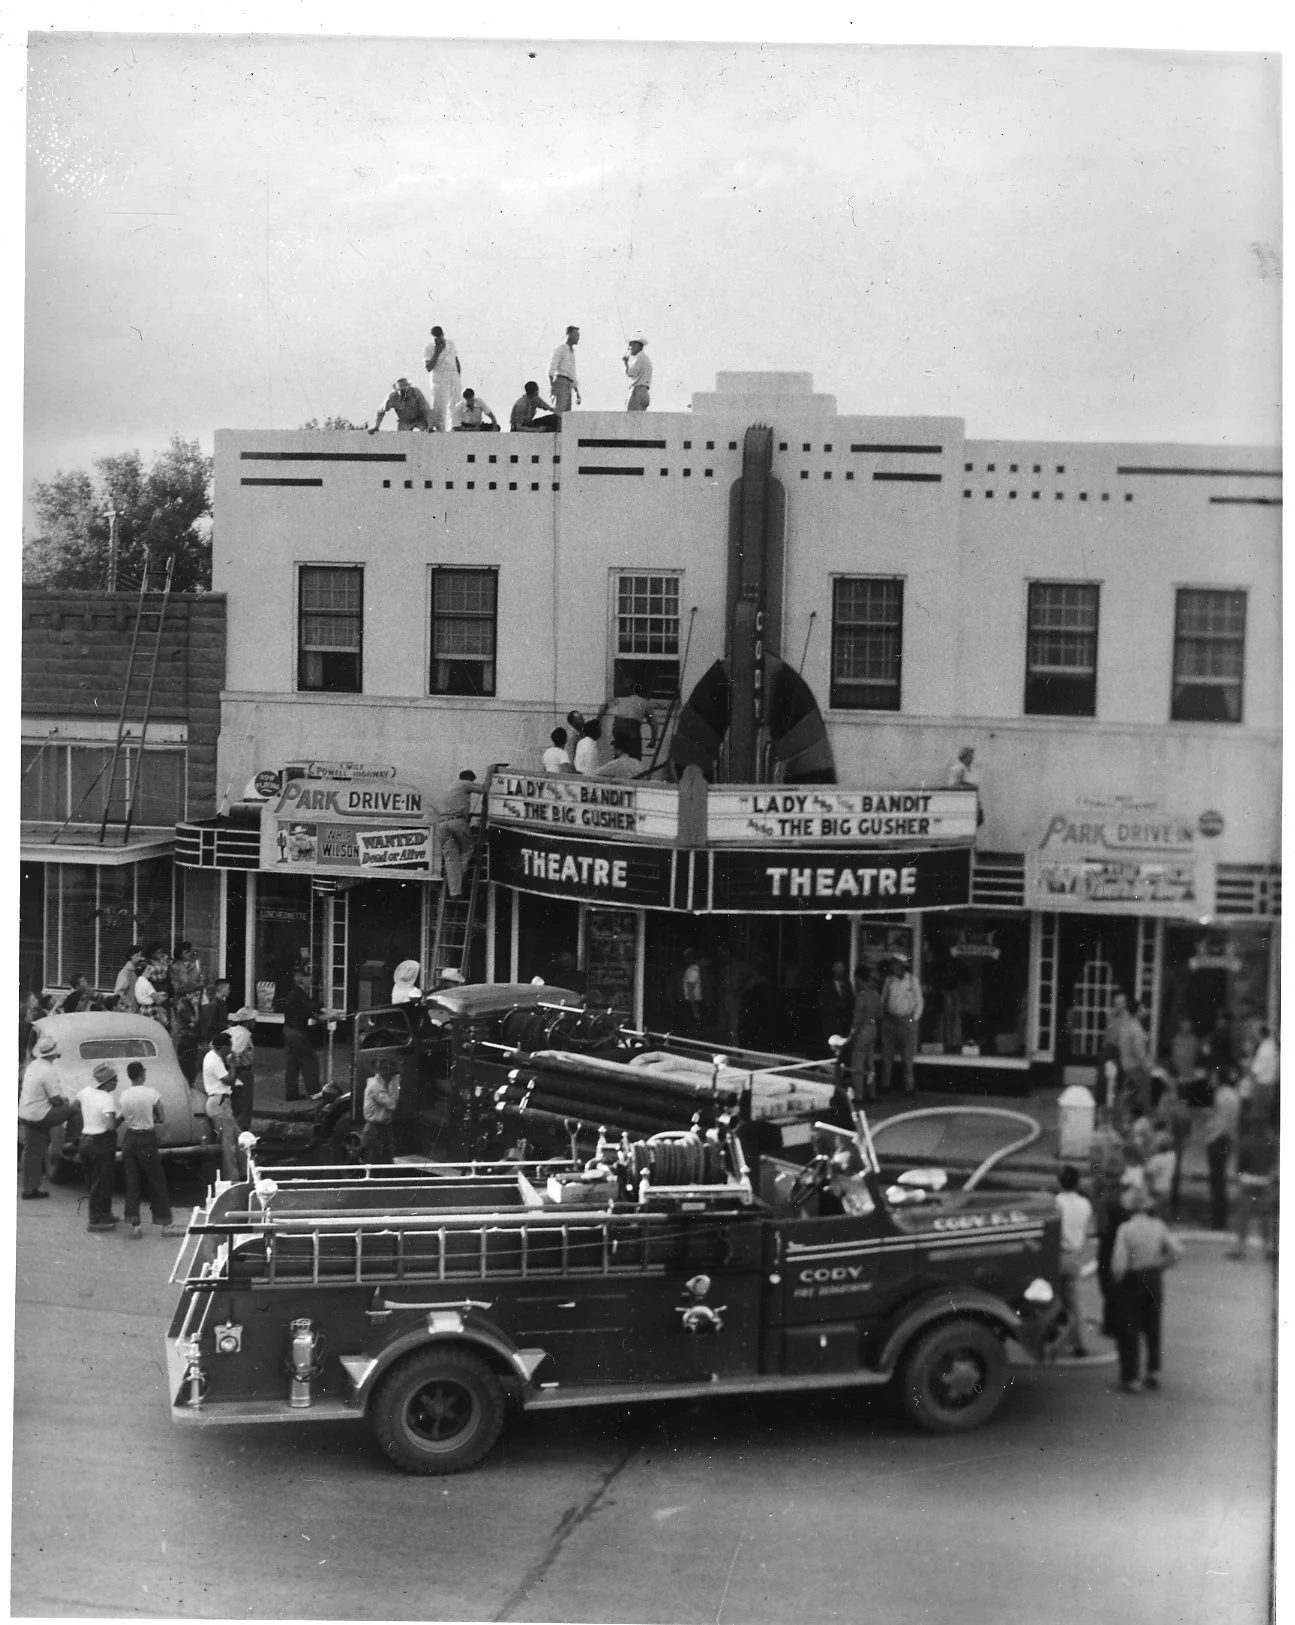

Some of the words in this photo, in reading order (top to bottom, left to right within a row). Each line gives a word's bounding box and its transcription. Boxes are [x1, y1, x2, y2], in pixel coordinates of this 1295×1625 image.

[273, 782, 340, 813] PARK
[580, 785, 634, 808] BANDIT
[862, 795, 932, 813] BANDIT
[523, 801, 548, 820] THE
[551, 804, 577, 824] BIG
[581, 808, 637, 831] GUSHER
[777, 818, 814, 836] THE
[821, 818, 852, 836] BIG
[858, 818, 930, 835] GUSHER
[361, 832, 427, 850] WANTED
[322, 843, 360, 858] WILSON
[362, 850, 388, 864] Dead
[400, 848, 426, 861] Alive
[520, 847, 628, 888] THEATRE
[766, 867, 917, 896] THEATRE
[799, 1265, 863, 1283] CODY
